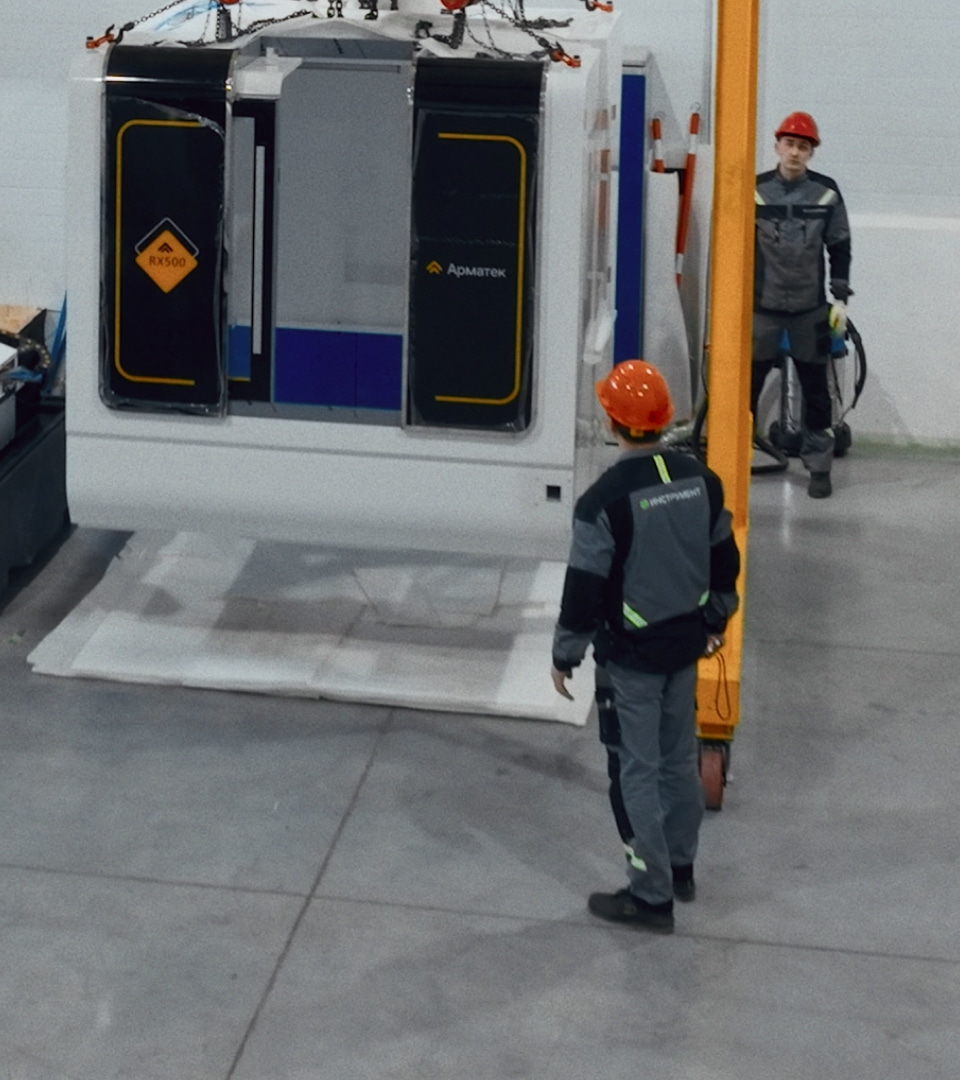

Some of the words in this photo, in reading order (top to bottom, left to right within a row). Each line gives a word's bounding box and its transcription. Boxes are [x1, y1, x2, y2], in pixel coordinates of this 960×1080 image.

[148, 255, 186, 268] RX500
[446, 262, 507, 279] Арматек
[649, 486, 701, 508] ИНСТРУМЕНТ
